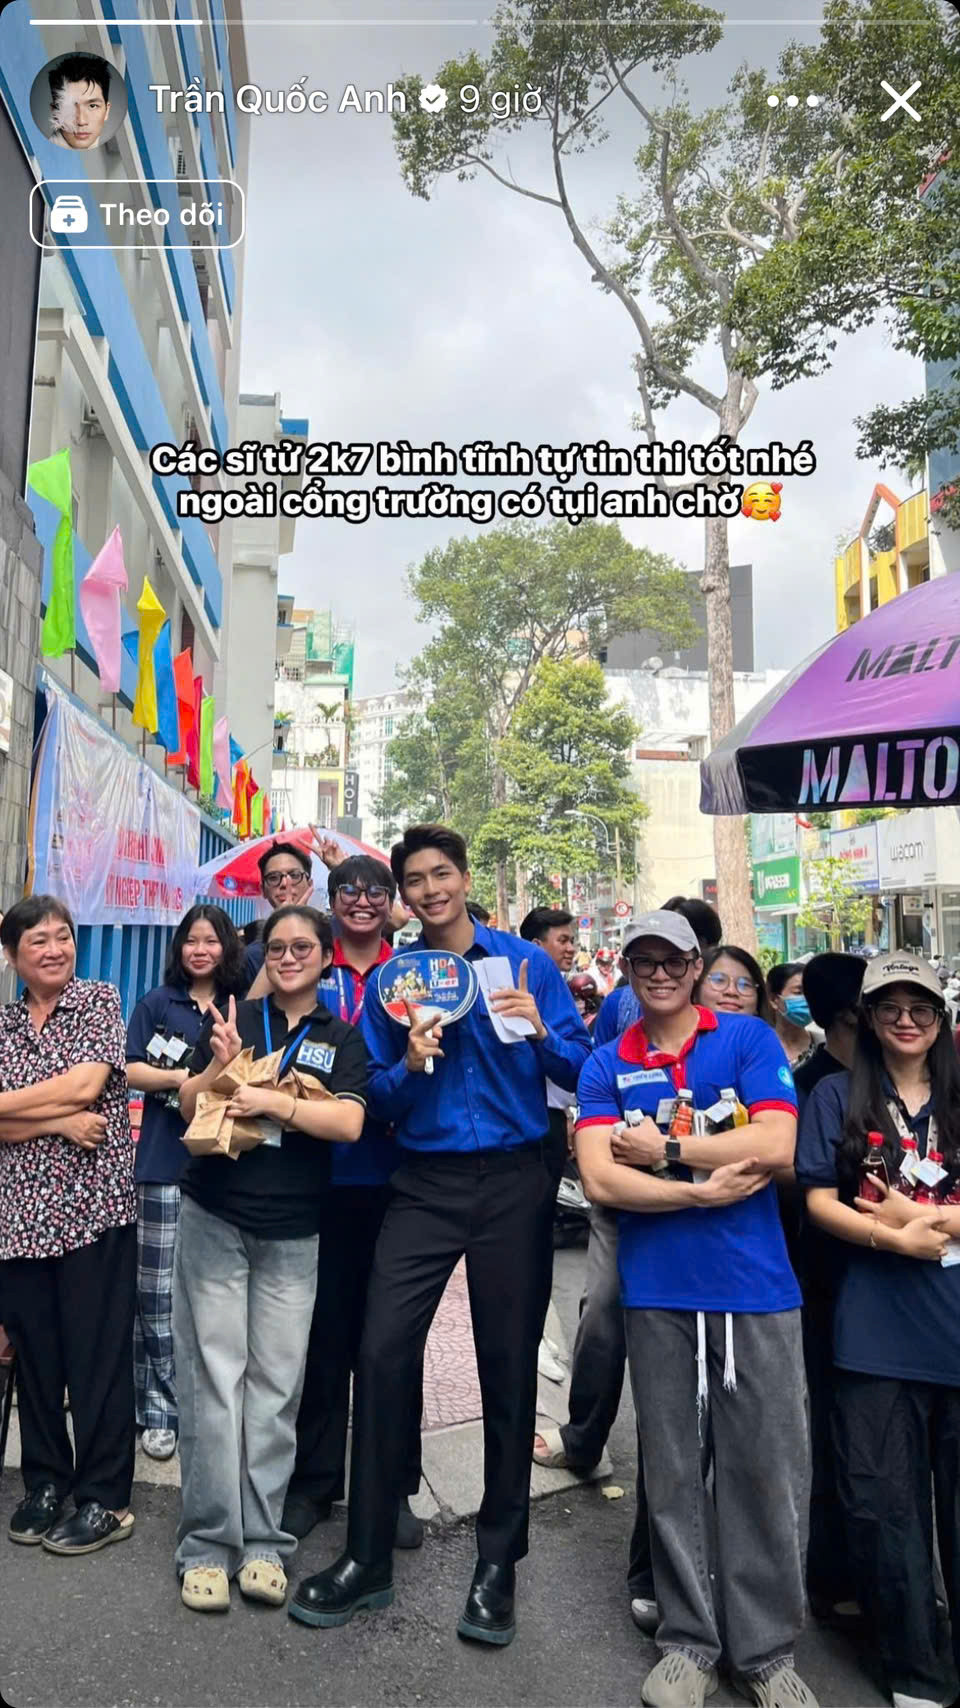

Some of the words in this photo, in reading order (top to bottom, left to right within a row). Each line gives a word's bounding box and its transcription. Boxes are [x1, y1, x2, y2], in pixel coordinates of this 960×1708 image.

[797, 736, 960, 804] MALTO
[344, 774, 355, 817] HOT
[890, 839, 923, 862] wacom
[300, 1046, 335, 1069] HSU
